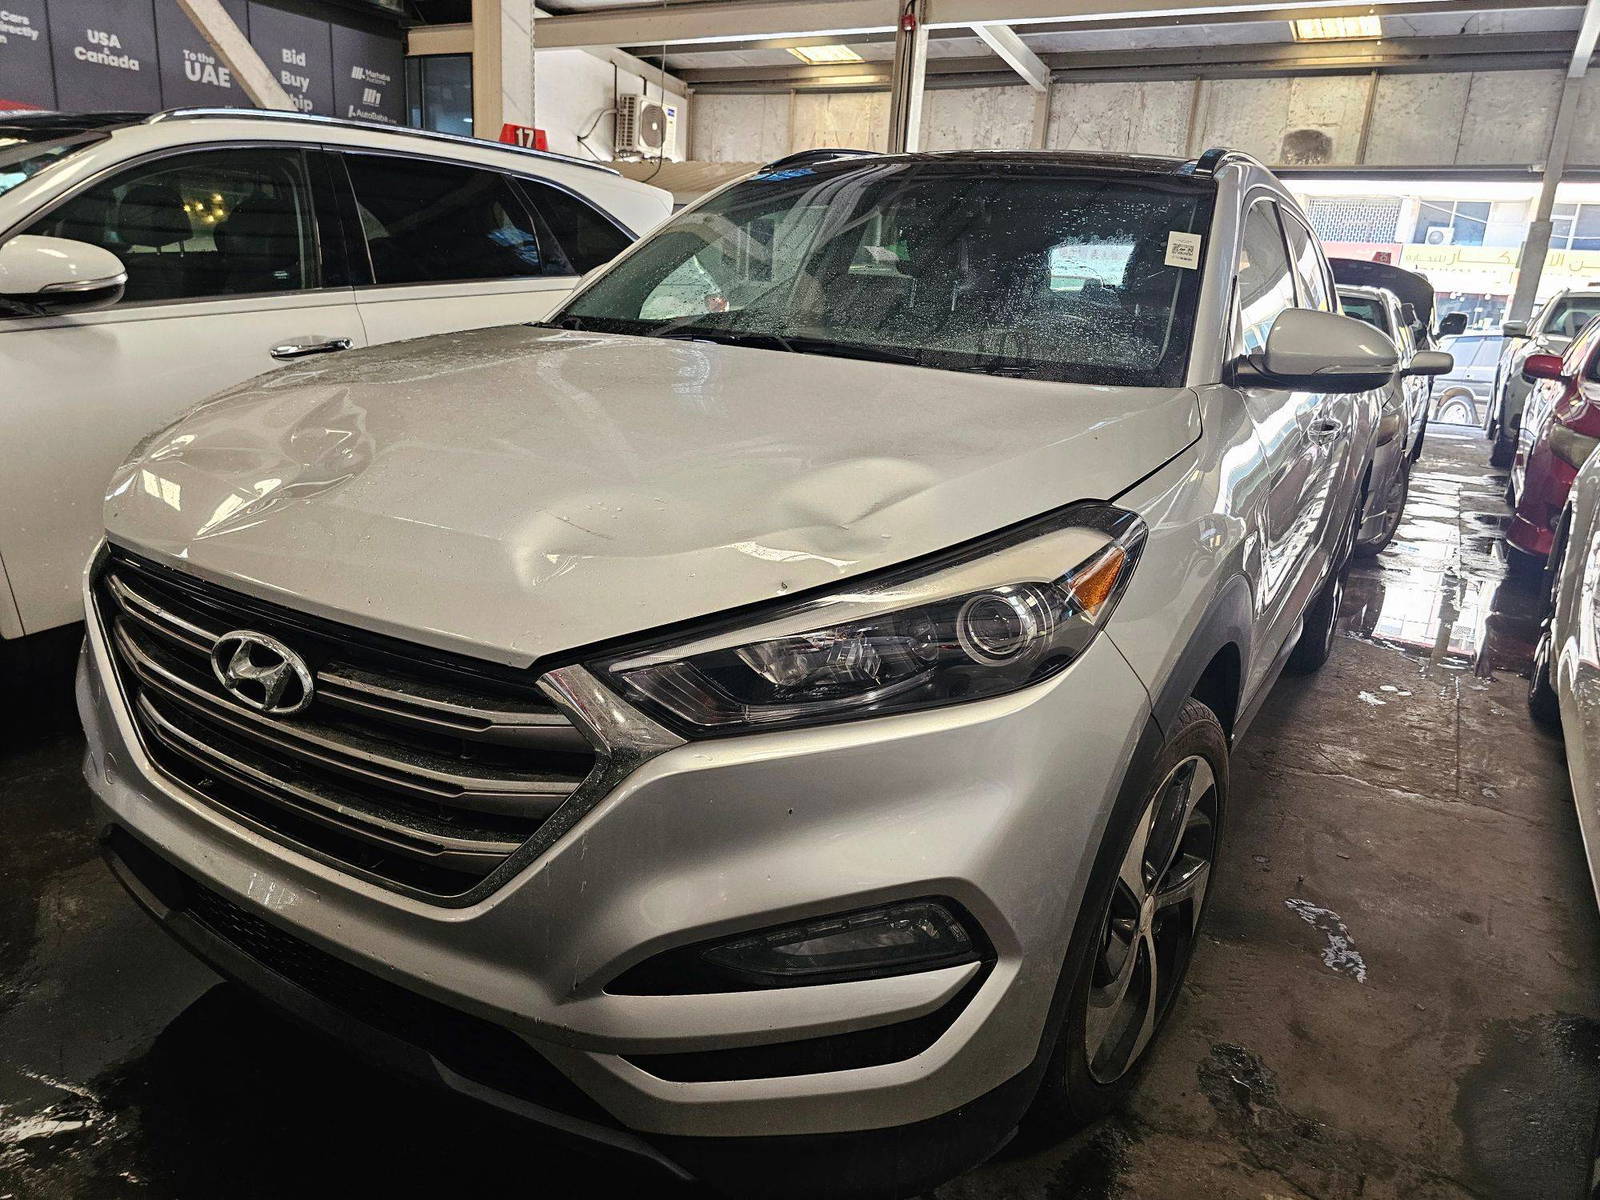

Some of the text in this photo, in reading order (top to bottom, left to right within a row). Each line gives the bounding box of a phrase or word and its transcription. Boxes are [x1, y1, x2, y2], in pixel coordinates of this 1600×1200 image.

[87, 28, 121, 49] USA
[74, 46, 140, 71] Canada
[183, 49, 216, 65] To the
[282, 48, 306, 67] Bid
[184, 60, 231, 88] UAE
[281, 70, 310, 93] Buy
[289, 93, 313, 112] hip
[516, 127, 534, 149] 17
